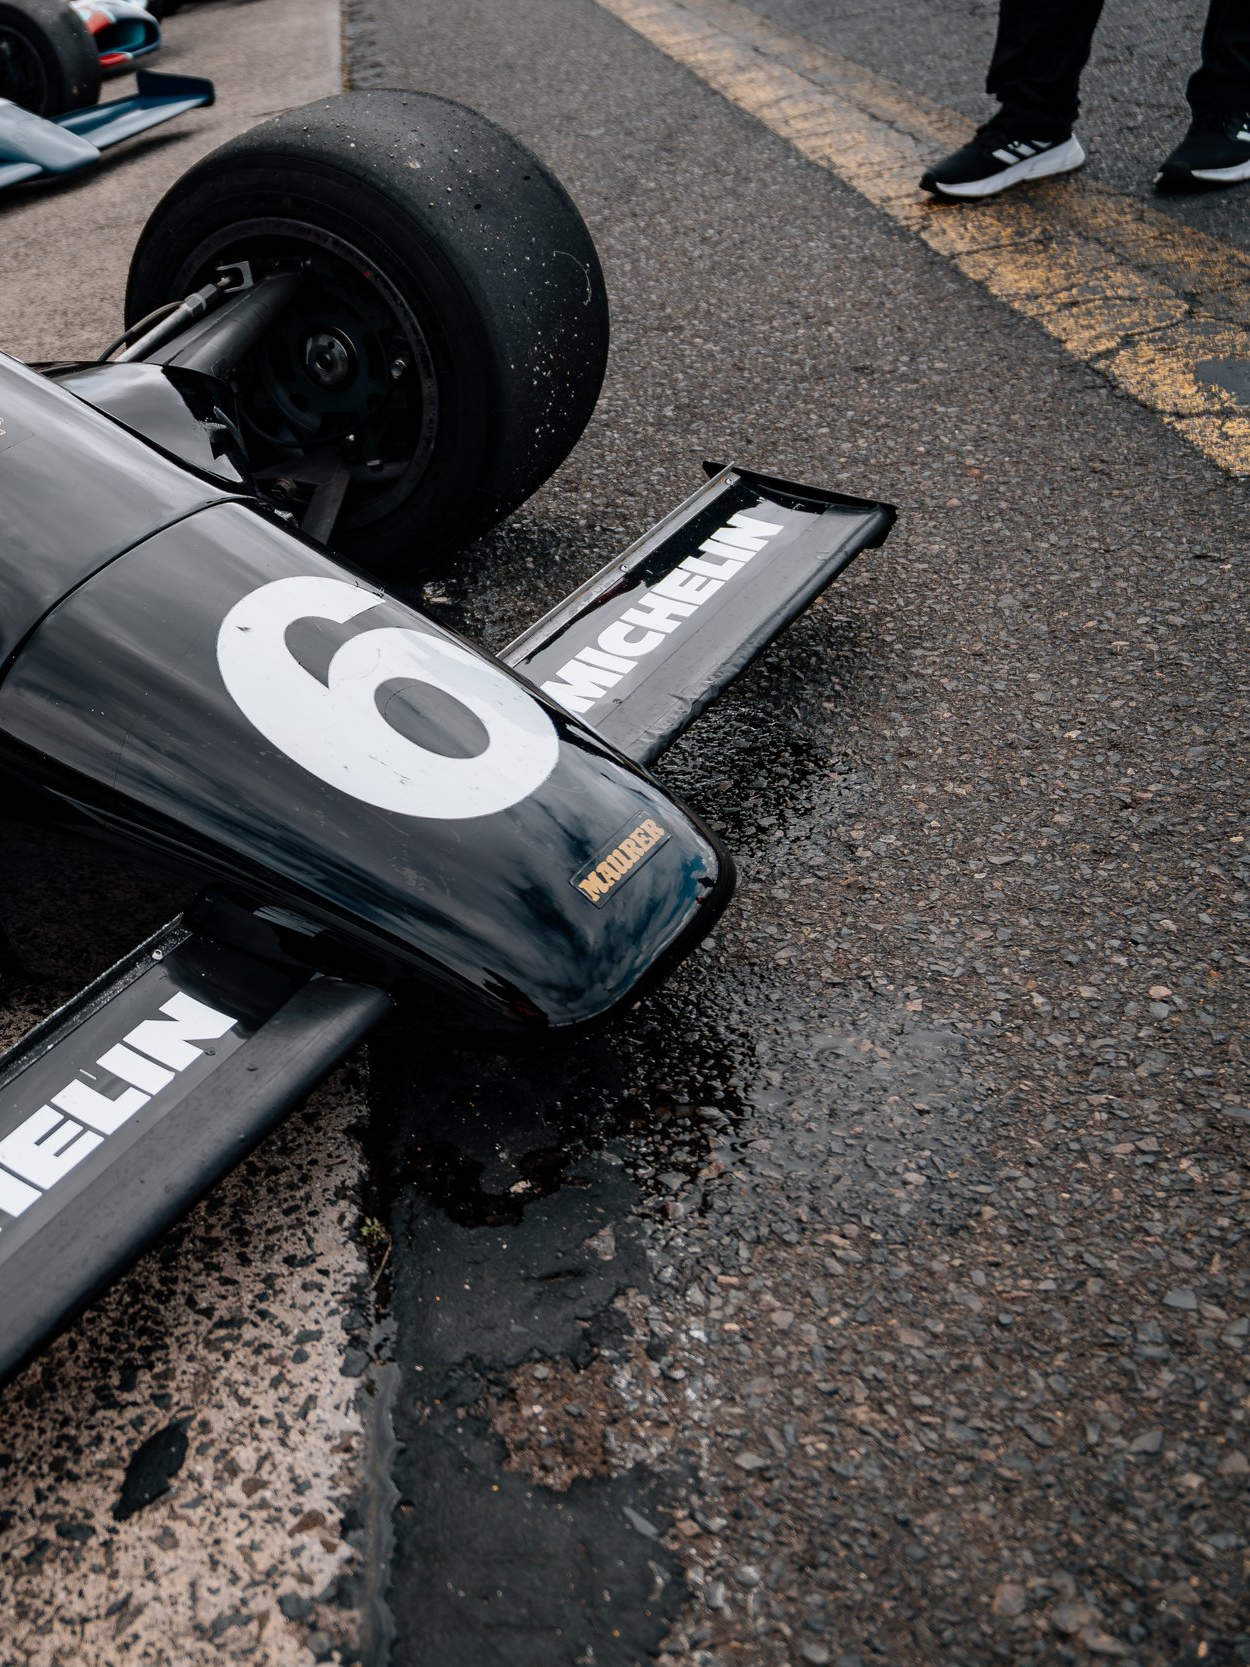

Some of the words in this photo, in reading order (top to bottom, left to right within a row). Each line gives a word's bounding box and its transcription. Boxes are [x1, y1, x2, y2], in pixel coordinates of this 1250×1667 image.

[217, 576, 560, 820] 6
[540, 513, 784, 713] MICHELIN
[578, 819, 665, 902] MAURER
